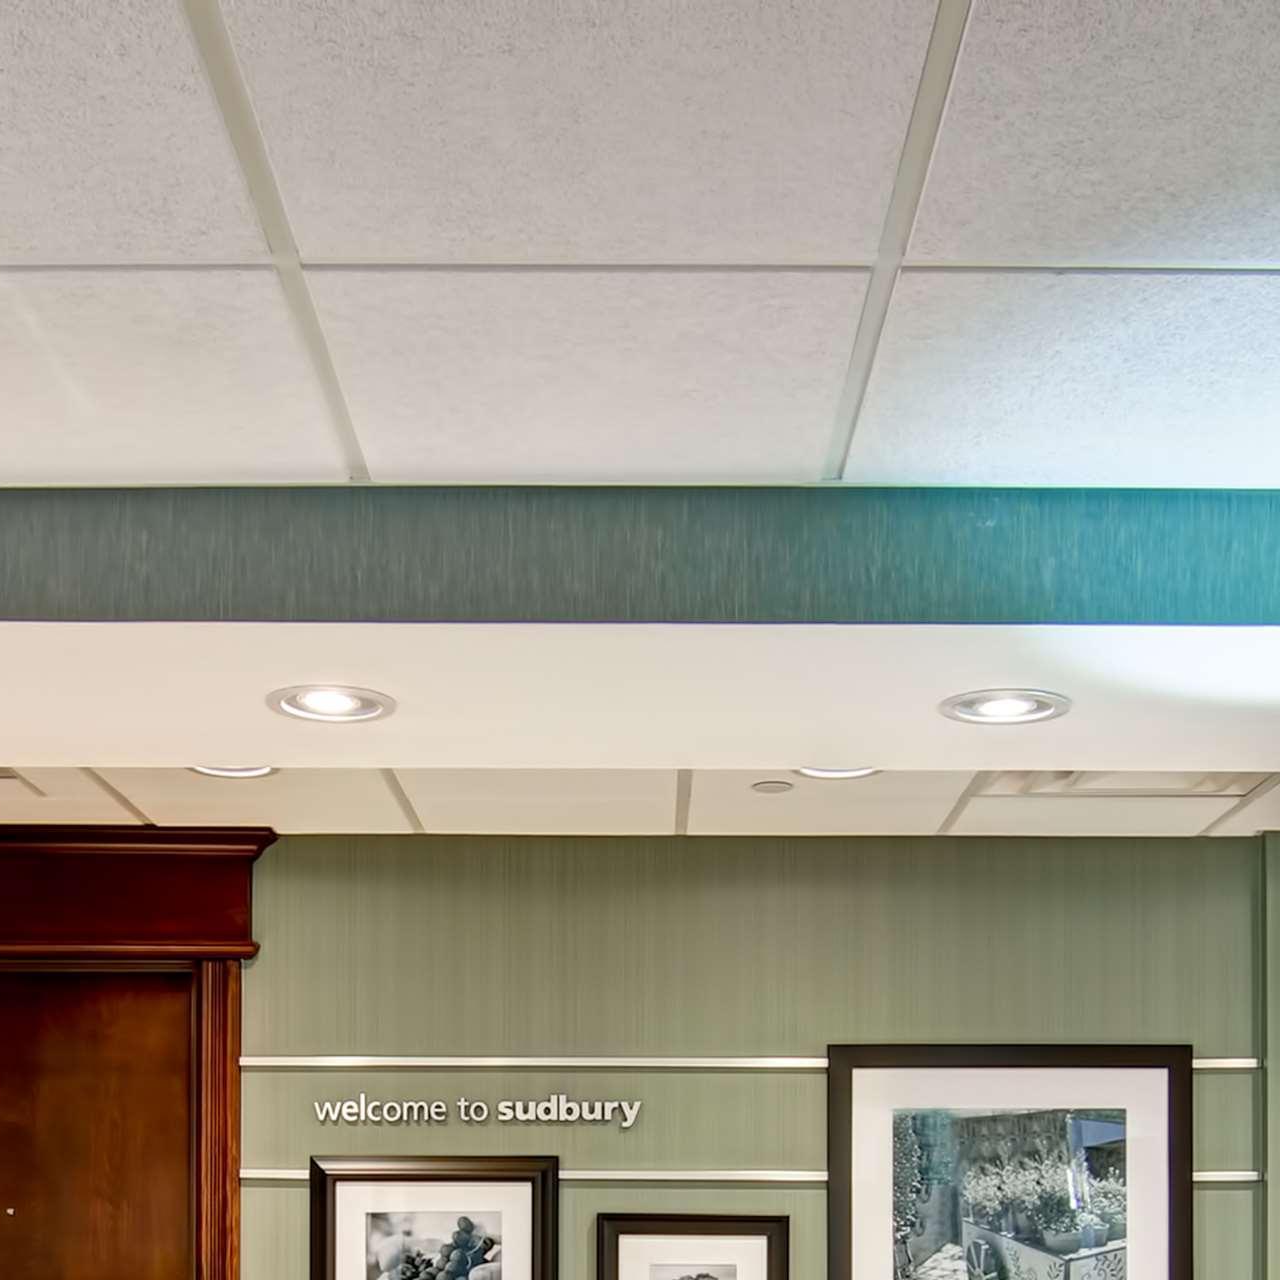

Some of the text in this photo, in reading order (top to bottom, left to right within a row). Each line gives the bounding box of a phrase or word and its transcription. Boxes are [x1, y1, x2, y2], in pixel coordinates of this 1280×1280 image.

[313, 1092, 642, 1128] welcome to sudbury
